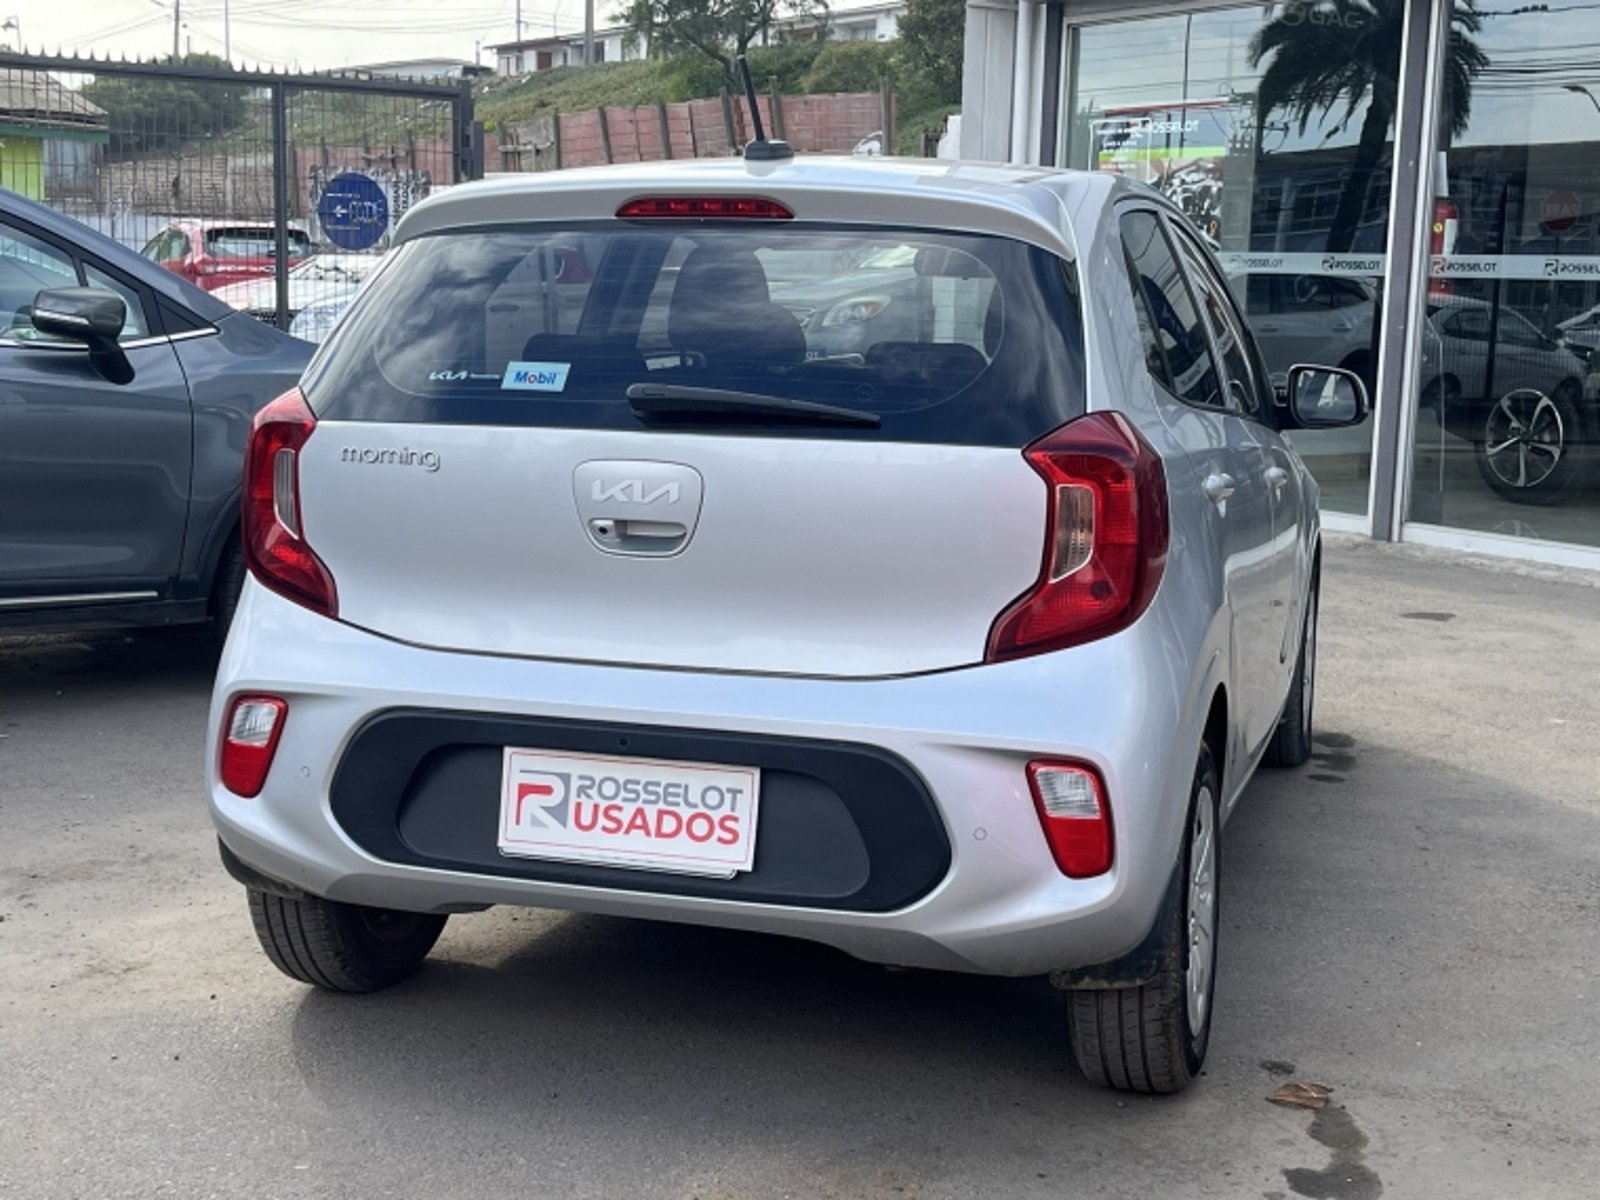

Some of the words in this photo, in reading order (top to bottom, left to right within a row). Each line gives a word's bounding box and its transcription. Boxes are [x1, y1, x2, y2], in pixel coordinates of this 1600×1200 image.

[513, 371, 557, 384] Mobil
[341, 446, 441, 473] morning
[591, 479, 681, 505] KIA
[576, 775, 743, 812] ROSSELOT
[573, 802, 740, 845] USADOS
